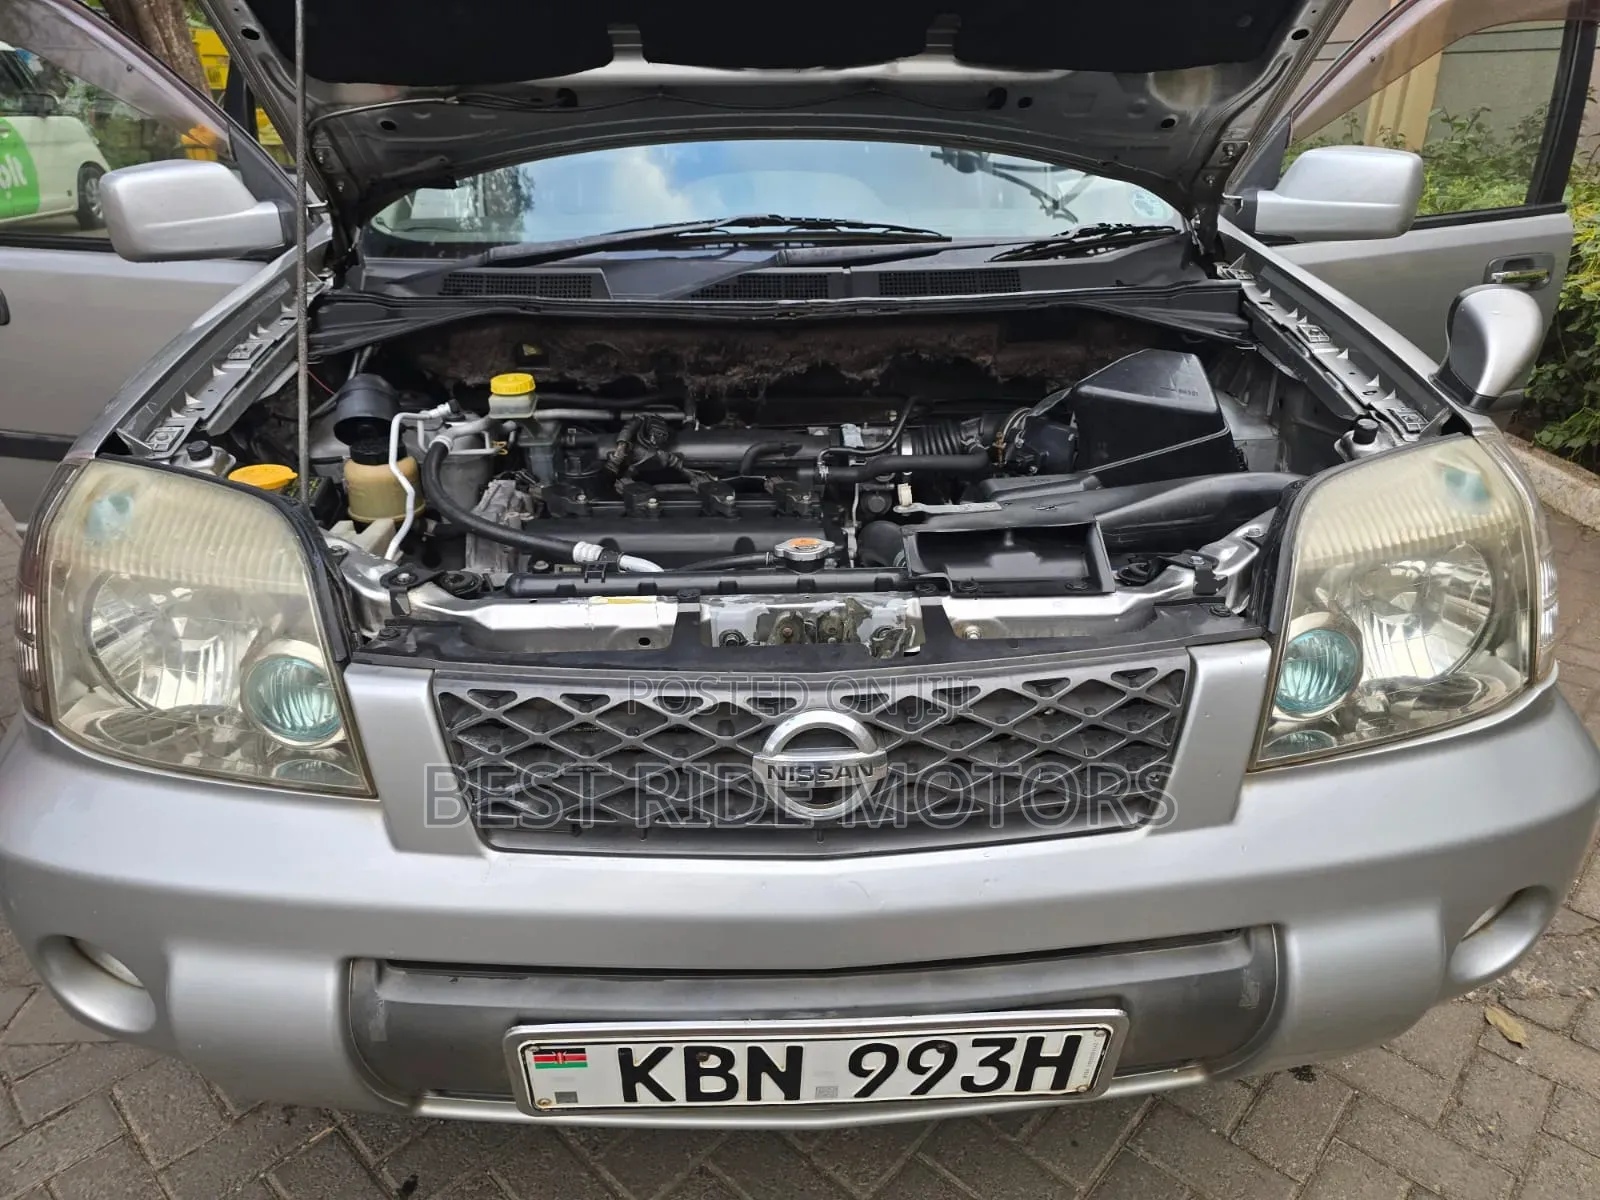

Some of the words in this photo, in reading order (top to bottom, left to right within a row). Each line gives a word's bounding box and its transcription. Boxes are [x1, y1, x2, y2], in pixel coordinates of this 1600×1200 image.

[767, 763, 875, 783] NISSAN
[617, 1045, 804, 1103] KBN
[848, 1034, 1083, 1099] 993H
